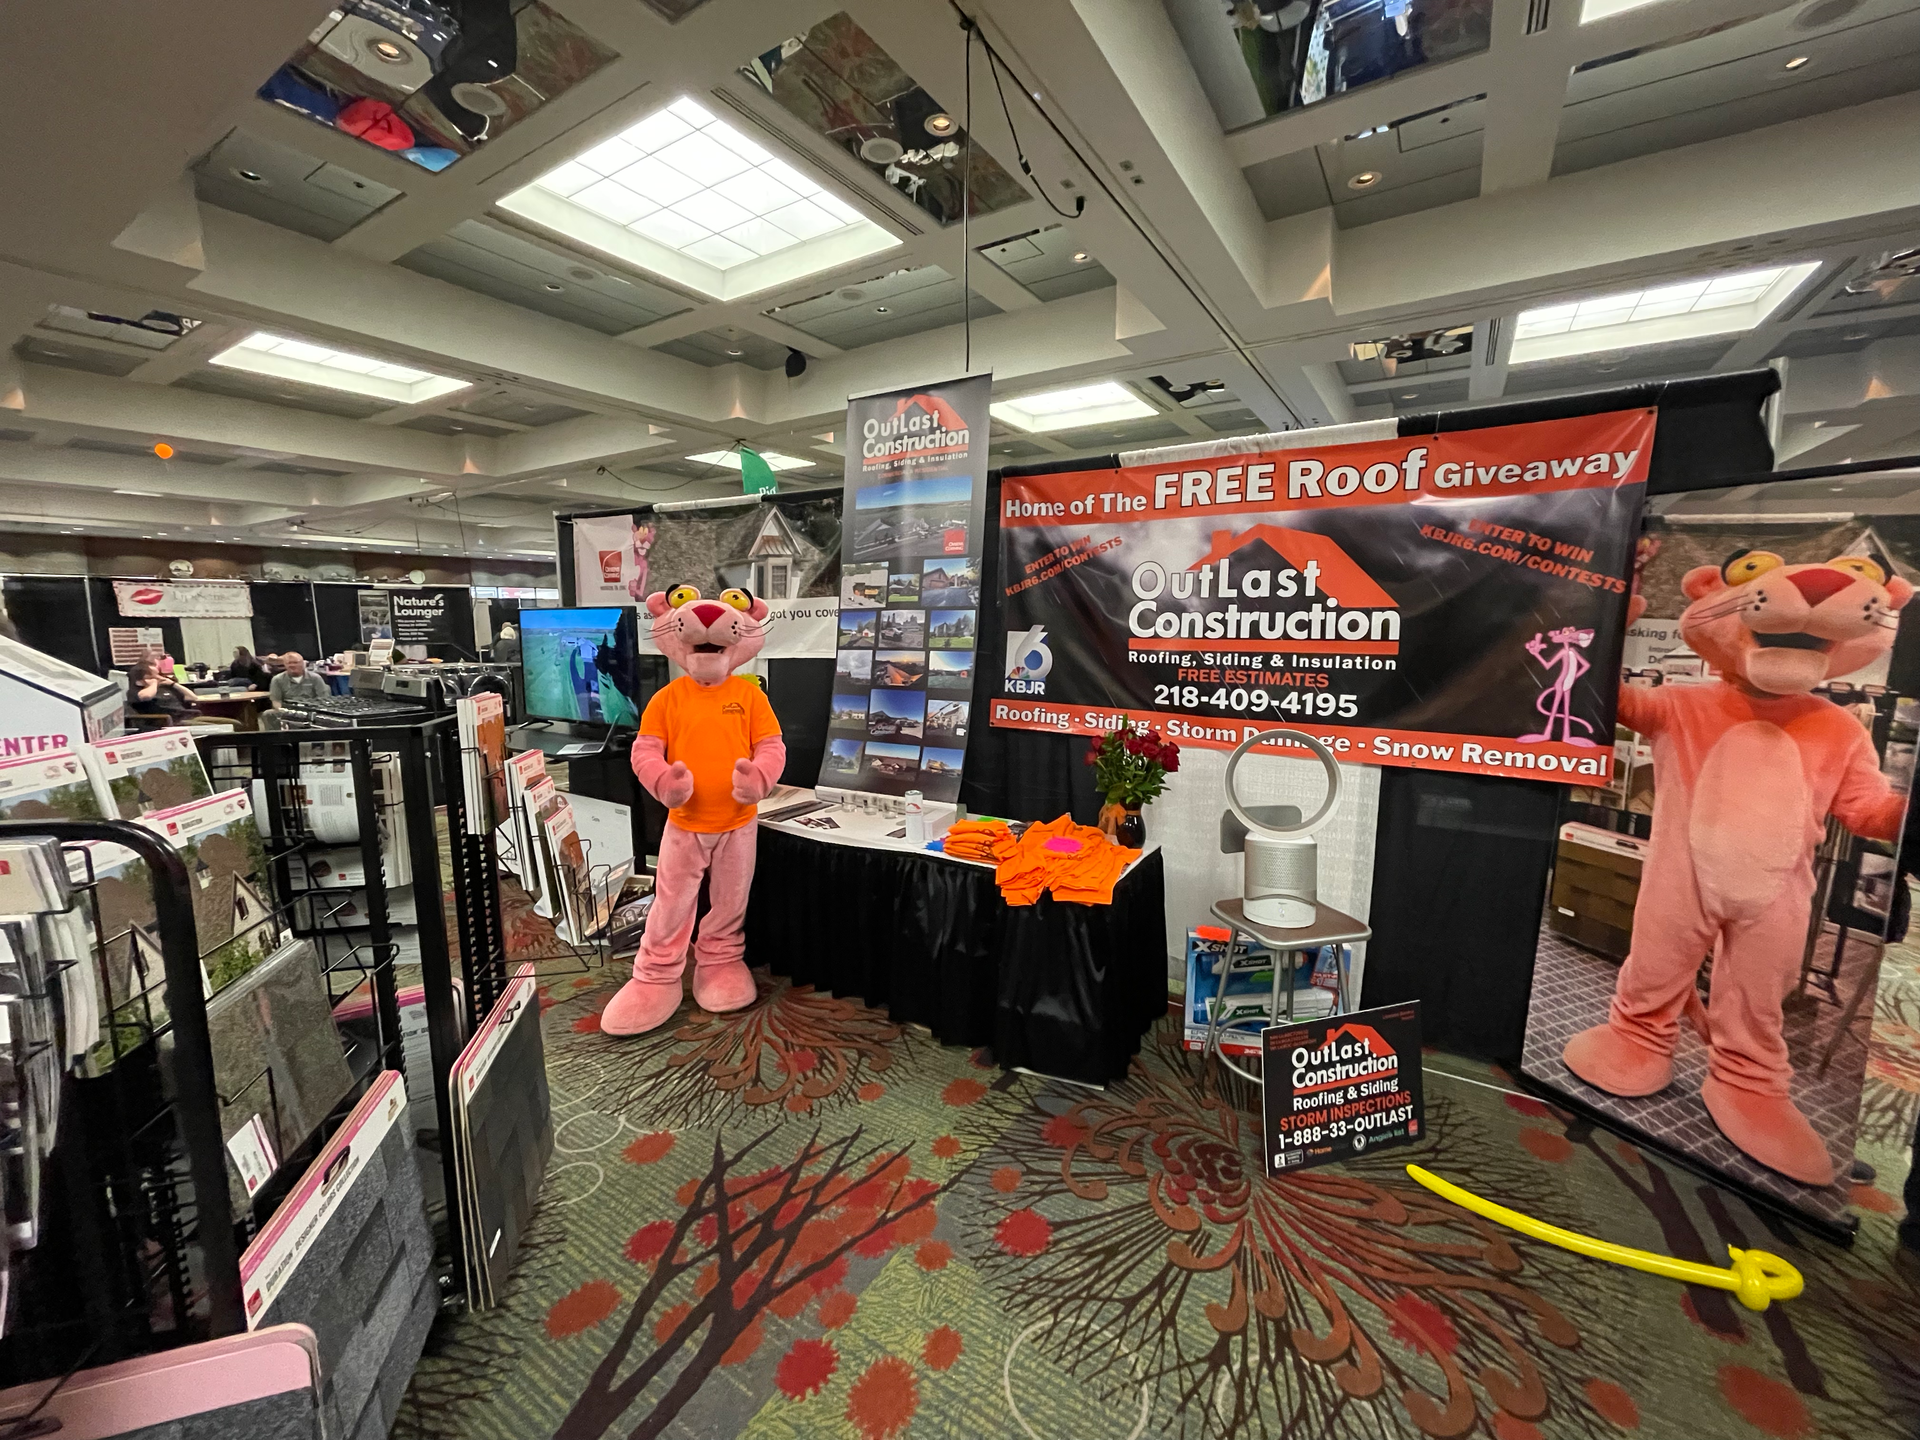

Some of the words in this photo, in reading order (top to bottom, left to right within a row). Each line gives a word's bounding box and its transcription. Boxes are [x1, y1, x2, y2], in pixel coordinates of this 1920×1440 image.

[863, 410, 940, 439] OutLast
[863, 427, 969, 458] Construction
[894, 458, 917, 468] Siding
[927, 452, 968, 463] Insulation
[1005, 499, 1065, 518] Home
[1069, 494, 1095, 514] of
[1100, 492, 1147, 513] The
[1153, 462, 1276, 510] FREE
[1288, 447, 1428, 499] Roof
[1433, 449, 1639, 490] Giveaway
[1024, 551, 1054, 574] ENTER
[1053, 546, 1068, 560] TO
[1069, 535, 1091, 552] WIN
[1468, 519, 1524, 544] ENTER
[1527, 534, 1552, 551] TO
[1552, 540, 1594, 564] WIN
[1005, 536, 1123, 597] KBJR6.COM/CONTESTS
[1420, 524, 1628, 594] KBJR6.COM/CONTESTS
[1131, 558, 1321, 600] OutLast
[393, 594, 445, 606] Nature's
[394, 605, 445, 618] Lounger
[770, 609, 787, 621] got
[790, 609, 811, 621] you
[1128, 597, 1400, 640] Construction
[1014, 624, 1053, 680] 6
[1128, 651, 1197, 668] Roofing,
[1203, 652, 1263, 669] Siding
[1270, 654, 1284, 667] &
[1292, 654, 1397, 671] Insulation
[1004, 680, 1045, 695] KBJR
[1178, 668, 1220, 683] FREE
[1225, 669, 1329, 688] ESTIMATES
[1154, 684, 1358, 718] 218-409-4195
[0, 734, 68, 756] NTER
[995, 704, 1070, 728] Roofing
[1166, 719, 1237, 742] Storm
[1243, 726, 1351, 754] Damge
[1372, 735, 1455, 762] Snow
[1462, 742, 1608, 776] Removal
[1291, 1037, 1370, 1069] OutLast
[1292, 1051, 1398, 1089] Construction
[1280, 1109, 1328, 1131] STORM
[1330, 1090, 1412, 1122] INSPECTIONS
[1293, 1090, 1344, 1111] Roofing
[1347, 1086, 1358, 1100] &
[1360, 1078, 1399, 1096] Siding
[1278, 1105, 1414, 1149] 1-888-33-OUTLAST
[1314, 1146, 1333, 1155] Home
